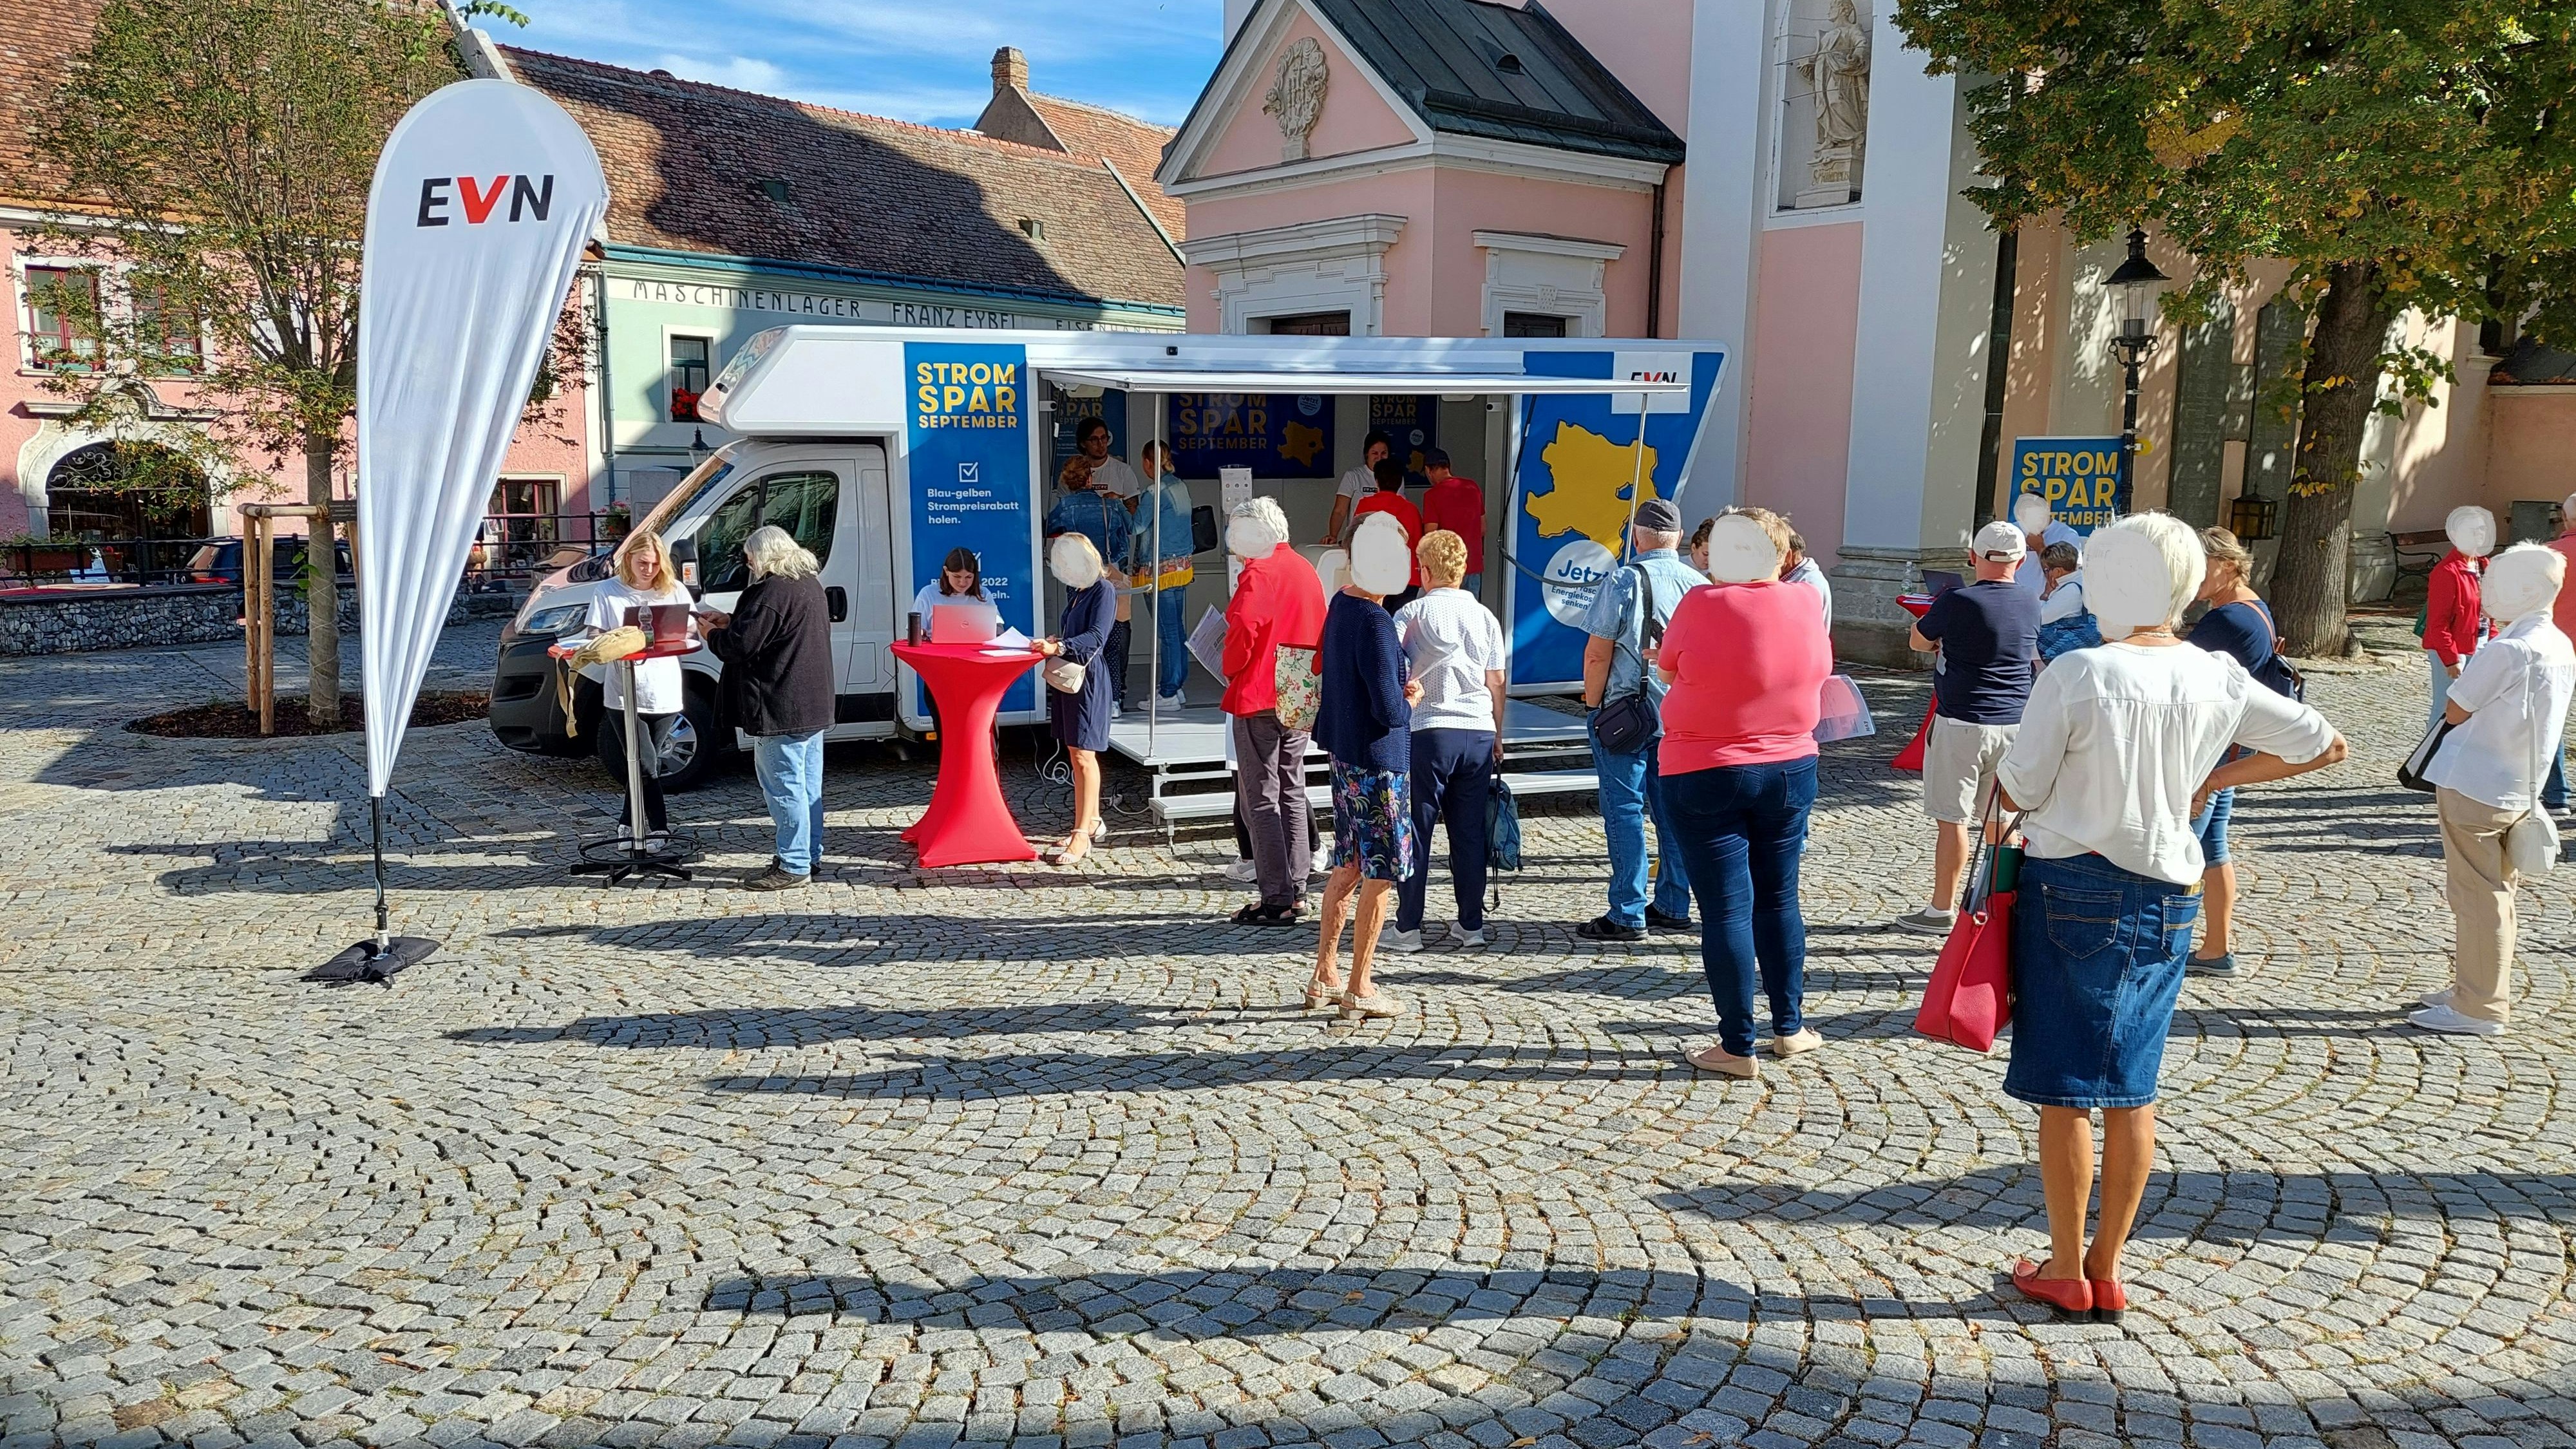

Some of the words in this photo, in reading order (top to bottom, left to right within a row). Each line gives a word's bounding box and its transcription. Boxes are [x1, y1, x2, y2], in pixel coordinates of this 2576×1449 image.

[417, 175, 554, 227] EVN
[634, 280, 860, 317] MASCHINENLAGER
[893, 303, 955, 327] FRANZ
[917, 363, 1016, 384] STROM
[918, 386, 1016, 413] SPAR
[1059, 402, 1103, 417] PAR
[1372, 404, 1416, 417] SPAR
[919, 415, 1018, 428] SEPTEMBER
[1179, 409, 1267, 435] SPAR
[1179, 438, 1267, 450] SEPTEMBER
[2022, 451, 2118, 477] STROM
[927, 488, 992, 499] Blau-gelben
[927, 502, 1019, 513] Strompreisrabatt
[929, 515, 961, 524] holen.
[1557, 559, 1609, 583] Jetz
[1551, 586, 1593, 603] Energiekos
